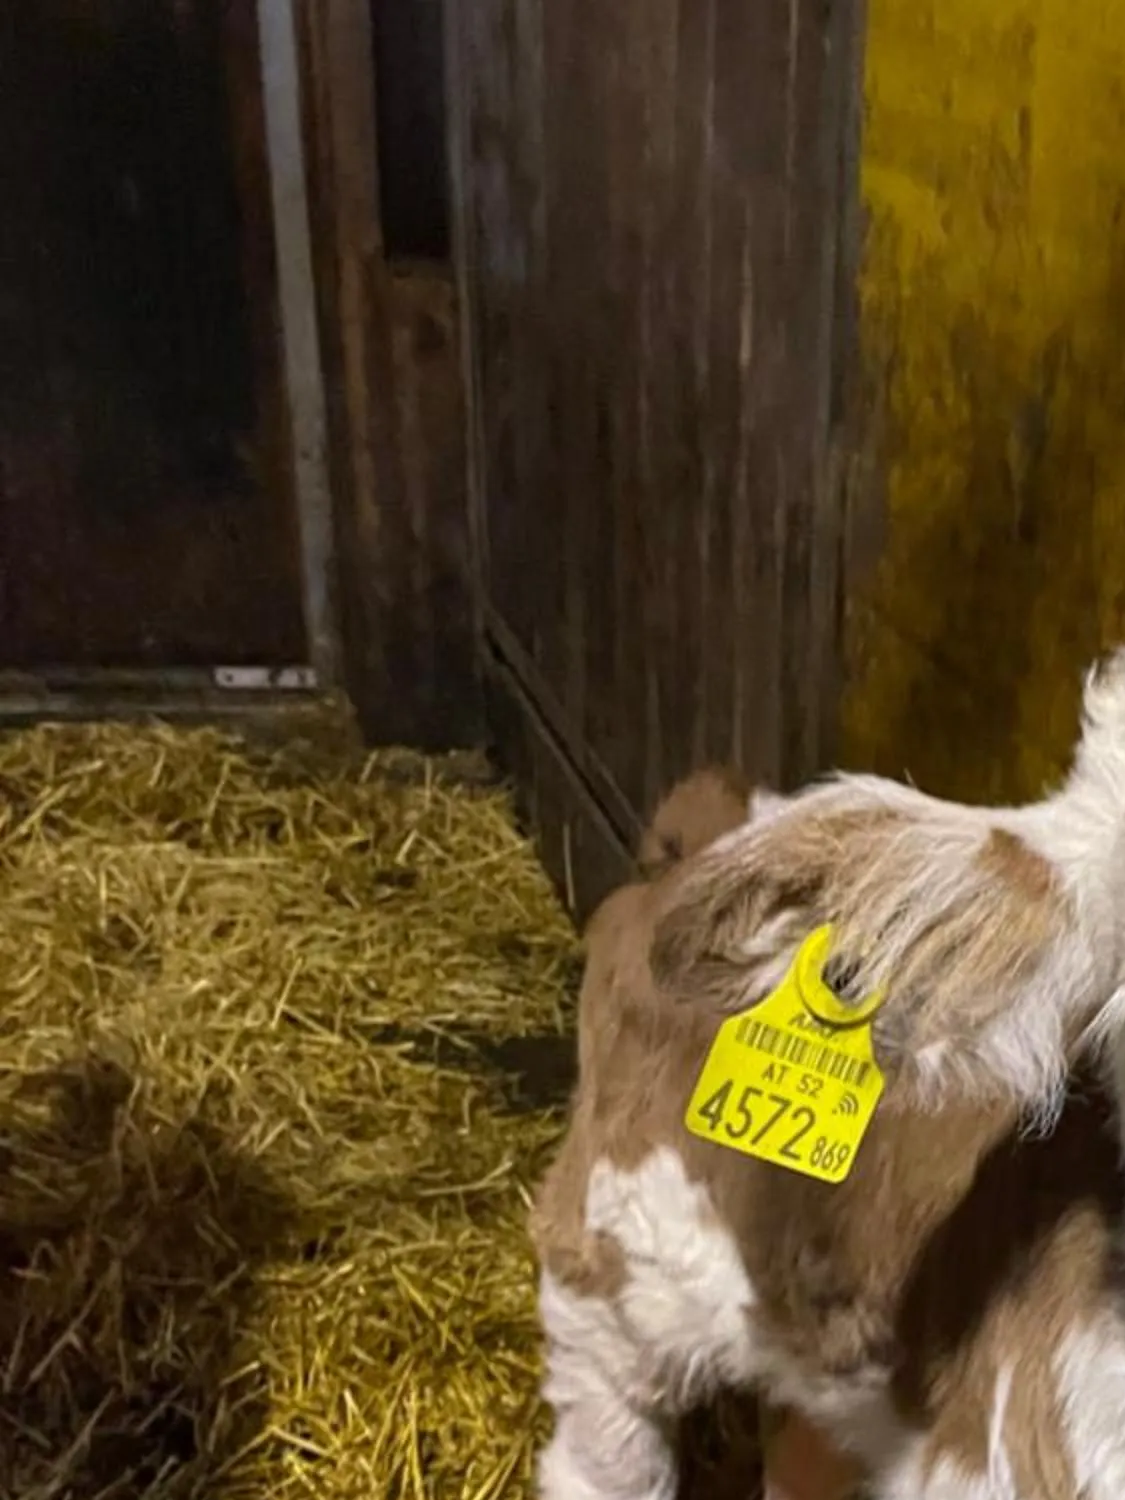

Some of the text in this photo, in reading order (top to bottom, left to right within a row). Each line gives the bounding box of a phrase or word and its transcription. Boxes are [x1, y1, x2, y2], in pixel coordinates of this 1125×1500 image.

[761, 1062, 825, 1098] AT 52
[698, 1078, 851, 1174] 4572 869
